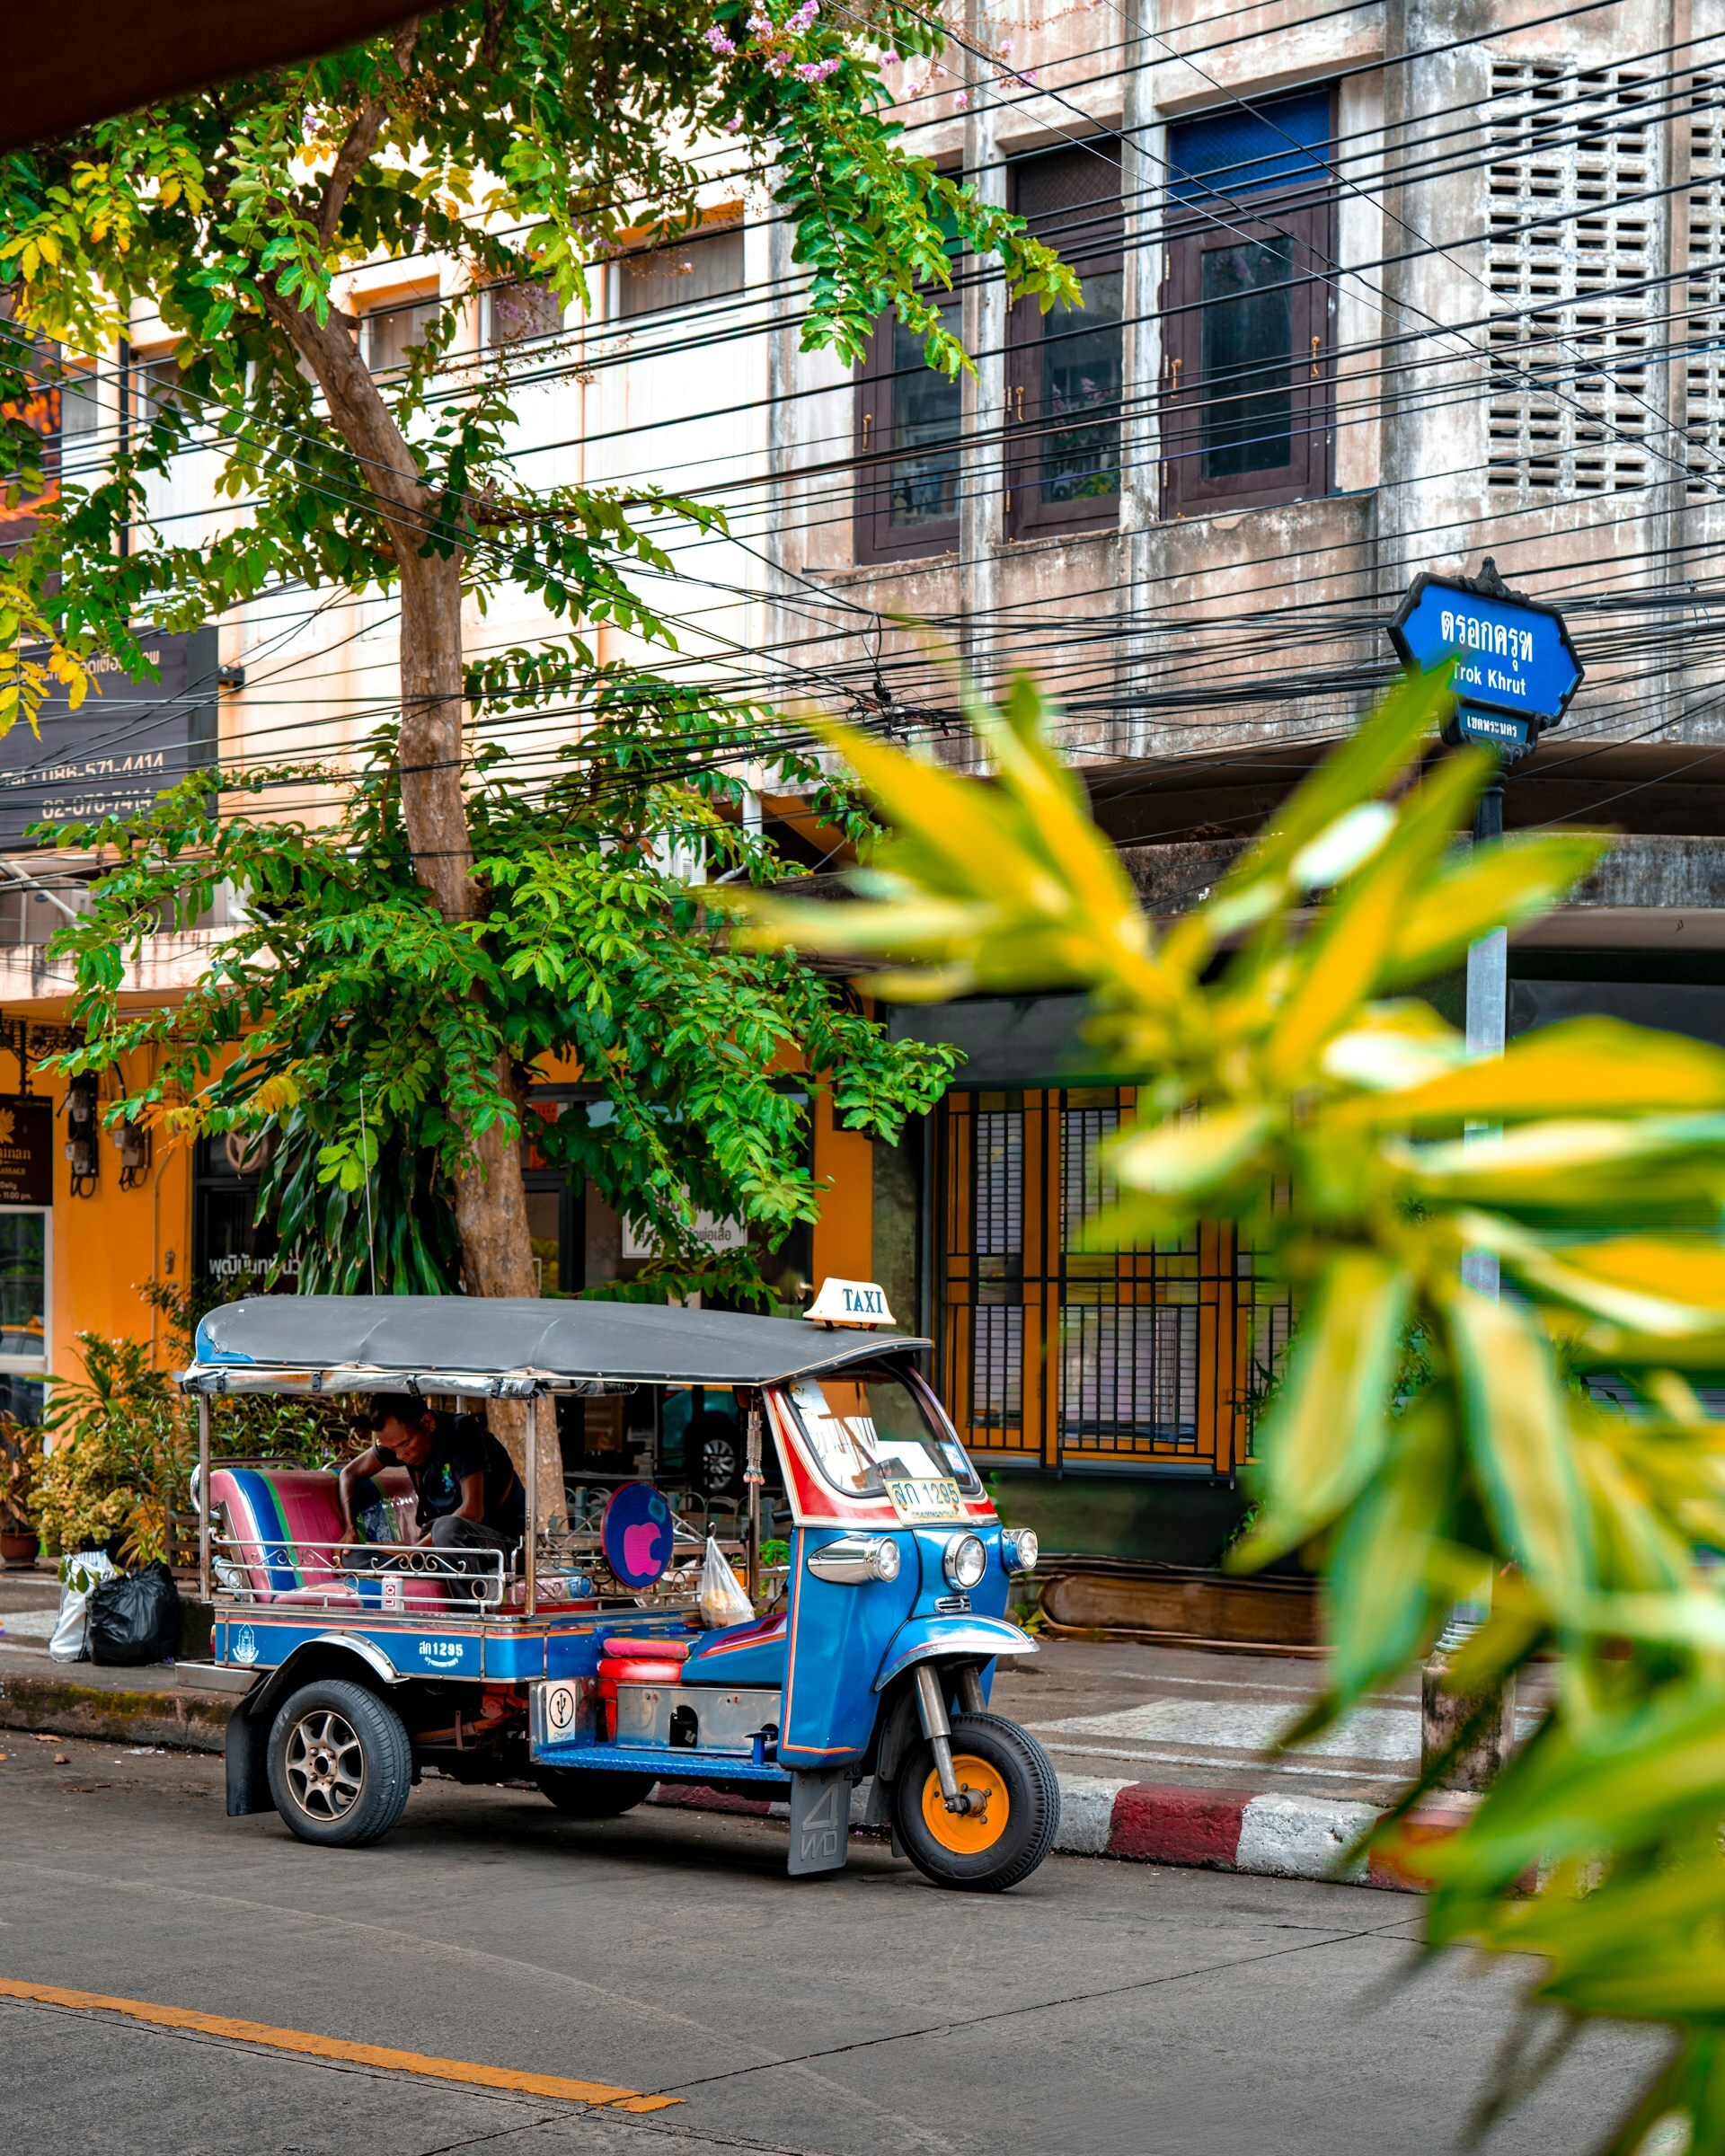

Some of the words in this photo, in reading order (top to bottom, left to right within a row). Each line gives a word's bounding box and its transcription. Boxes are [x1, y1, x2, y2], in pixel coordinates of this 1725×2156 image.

[1440, 610, 1534, 672] ตรอกครุฑ
[1488, 668, 1526, 696] Khrut
[1466, 715, 1518, 738] เขตพระนคร
[843, 1288, 883, 1314] TAXI
[923, 1482, 960, 1505] 1295
[385, 1586, 395, 1606] LO
